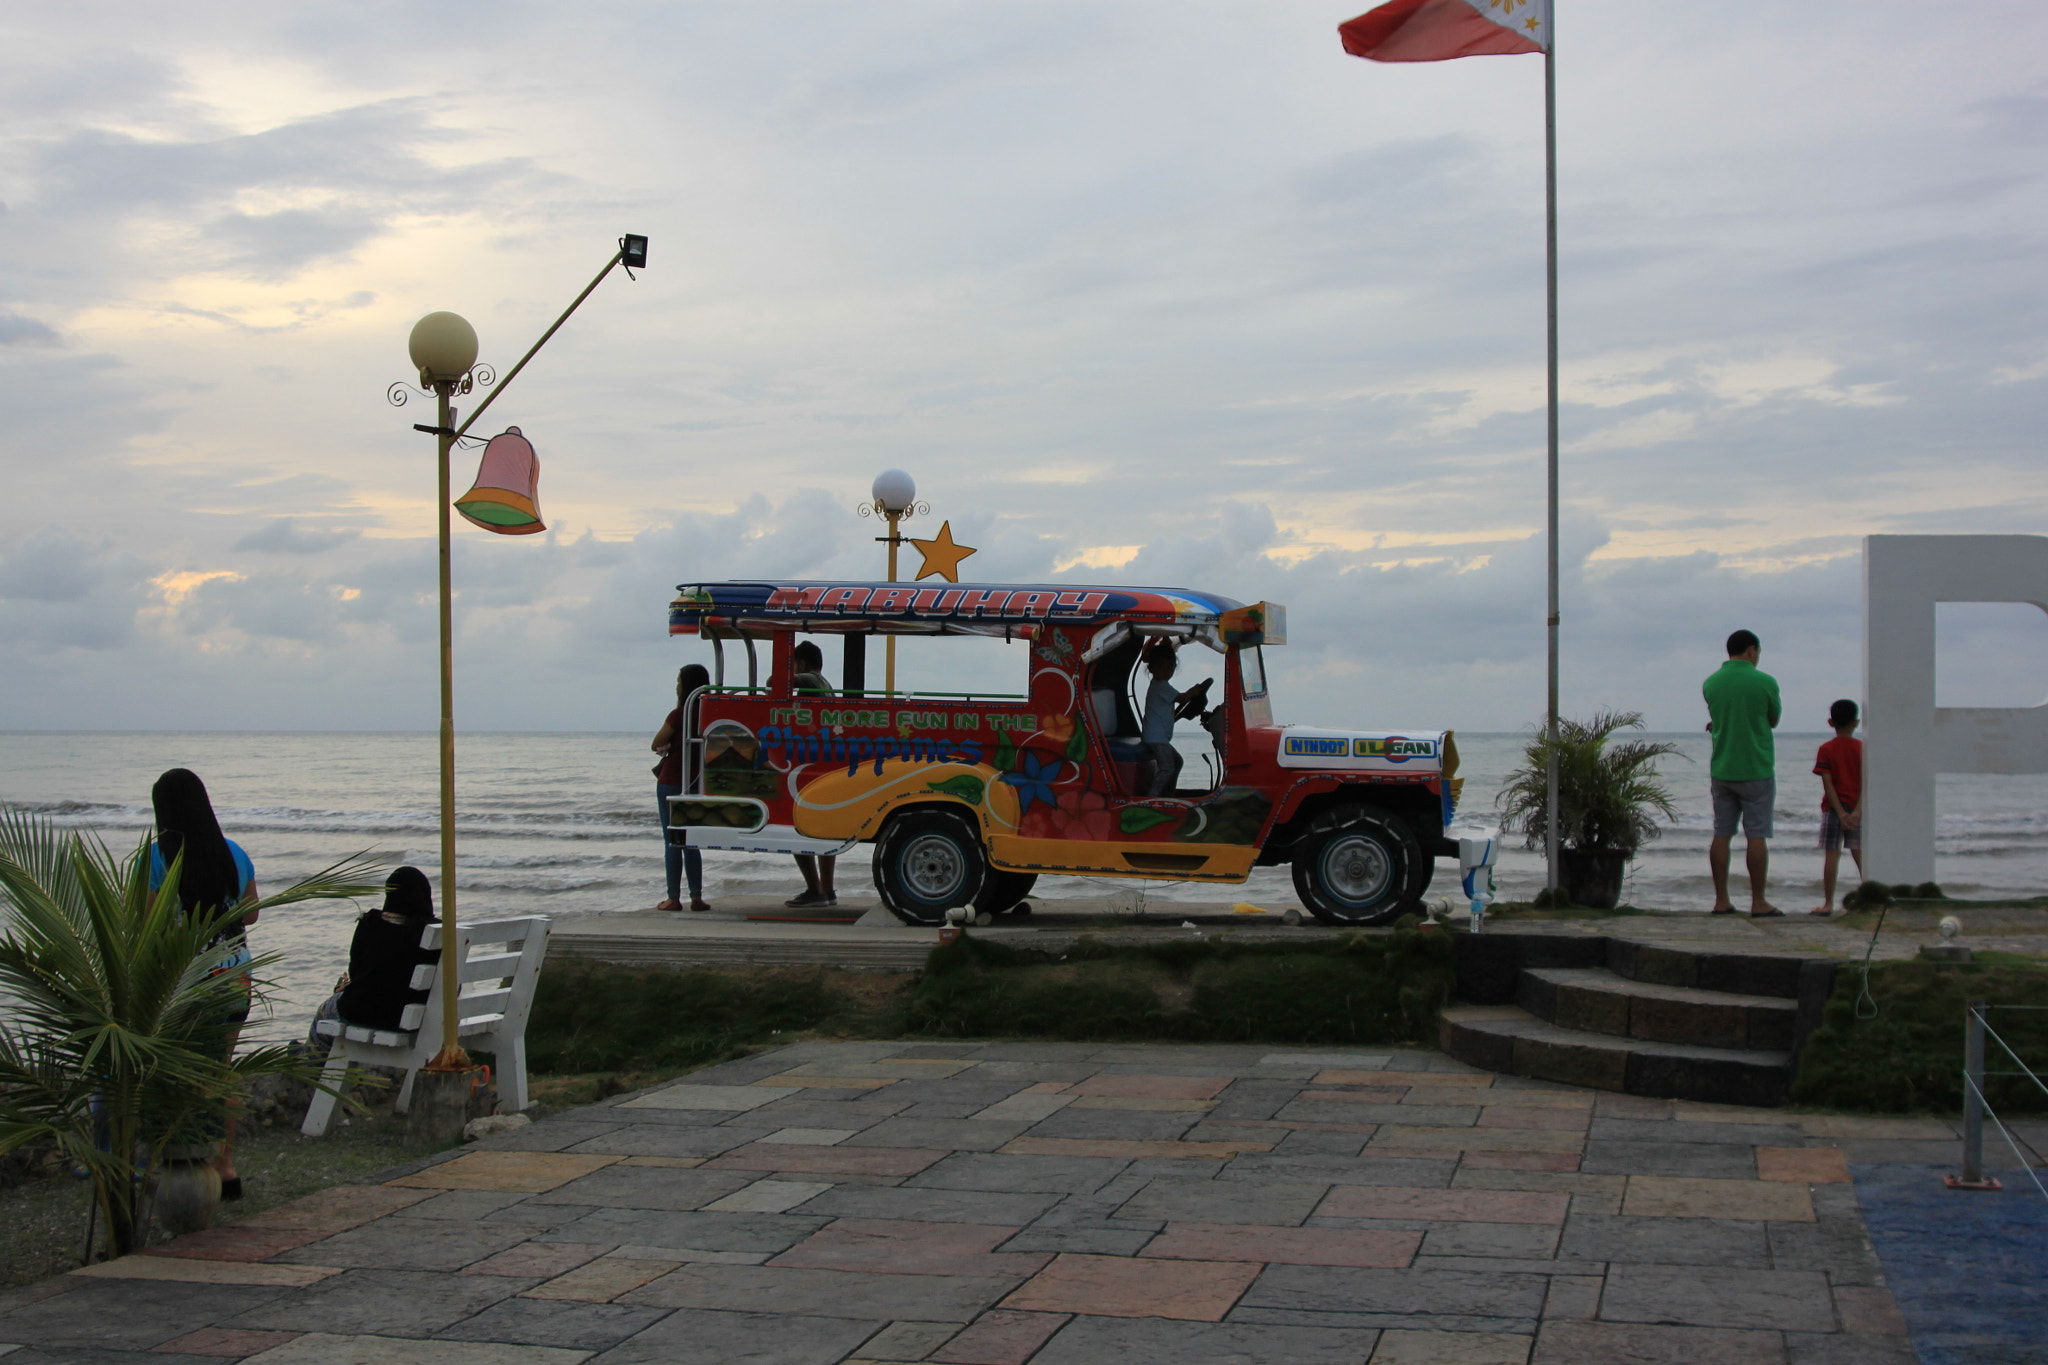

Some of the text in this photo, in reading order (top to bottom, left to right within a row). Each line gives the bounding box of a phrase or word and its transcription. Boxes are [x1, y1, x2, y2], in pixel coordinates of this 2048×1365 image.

[765, 586, 1109, 618] MABUHAY
[820, 708, 889, 728] MORE
[896, 710, 948, 729] FUN
[954, 712, 979, 729] IN
[985, 713, 1037, 732] THE
[755, 724, 984, 778] Philippines
[1291, 739, 1344, 753] NINDOT
